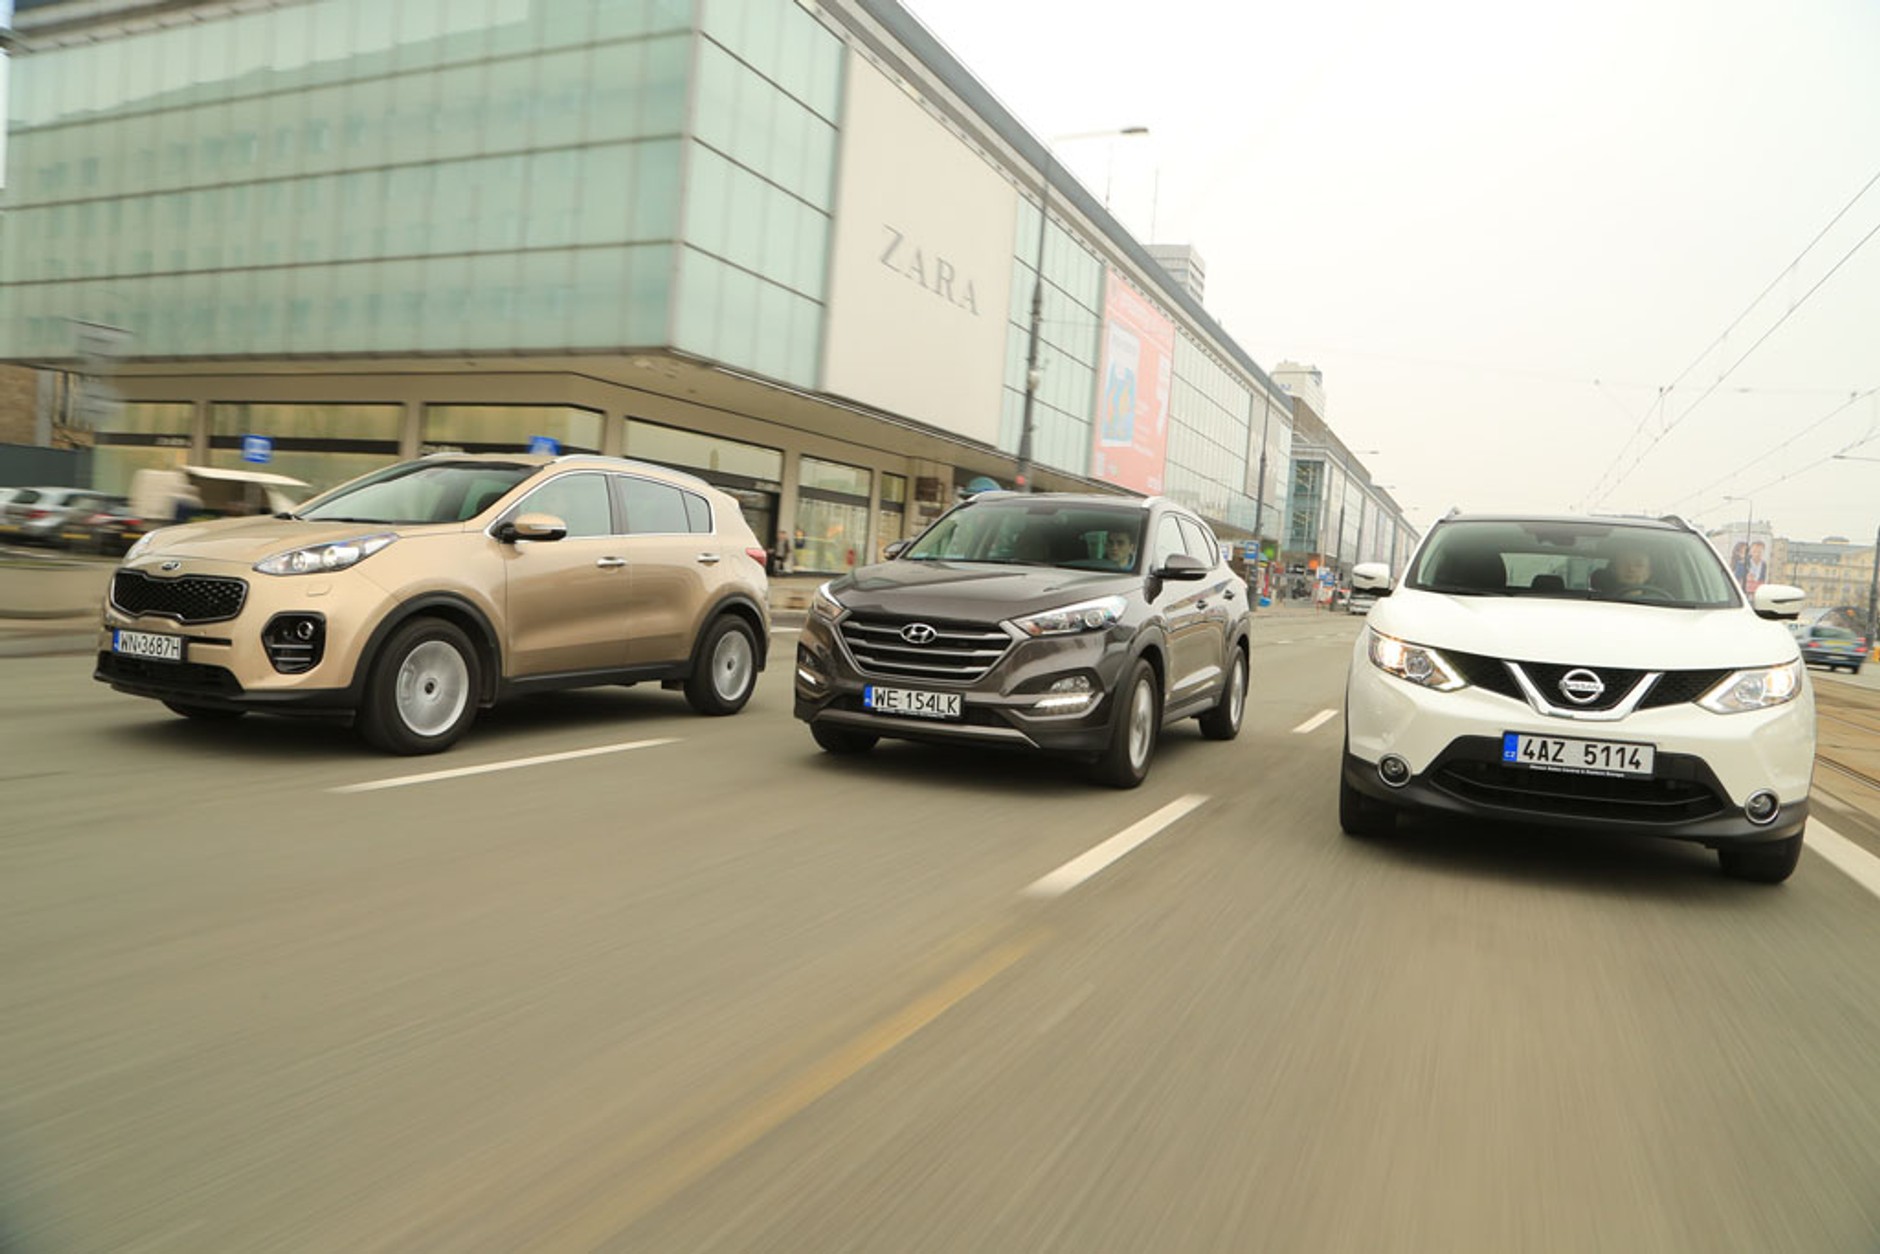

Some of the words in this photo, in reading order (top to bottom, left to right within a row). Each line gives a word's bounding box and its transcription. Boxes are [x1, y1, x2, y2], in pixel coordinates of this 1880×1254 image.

[879, 223, 980, 317] ZARA
[141, 634, 180, 657] 3687H
[874, 688, 899, 708] WE
[906, 691, 958, 714] 154LK
[1504, 750, 1516, 758] CZ
[1522, 738, 1566, 763] 4AZ
[1584, 743, 1642, 770] 5114
